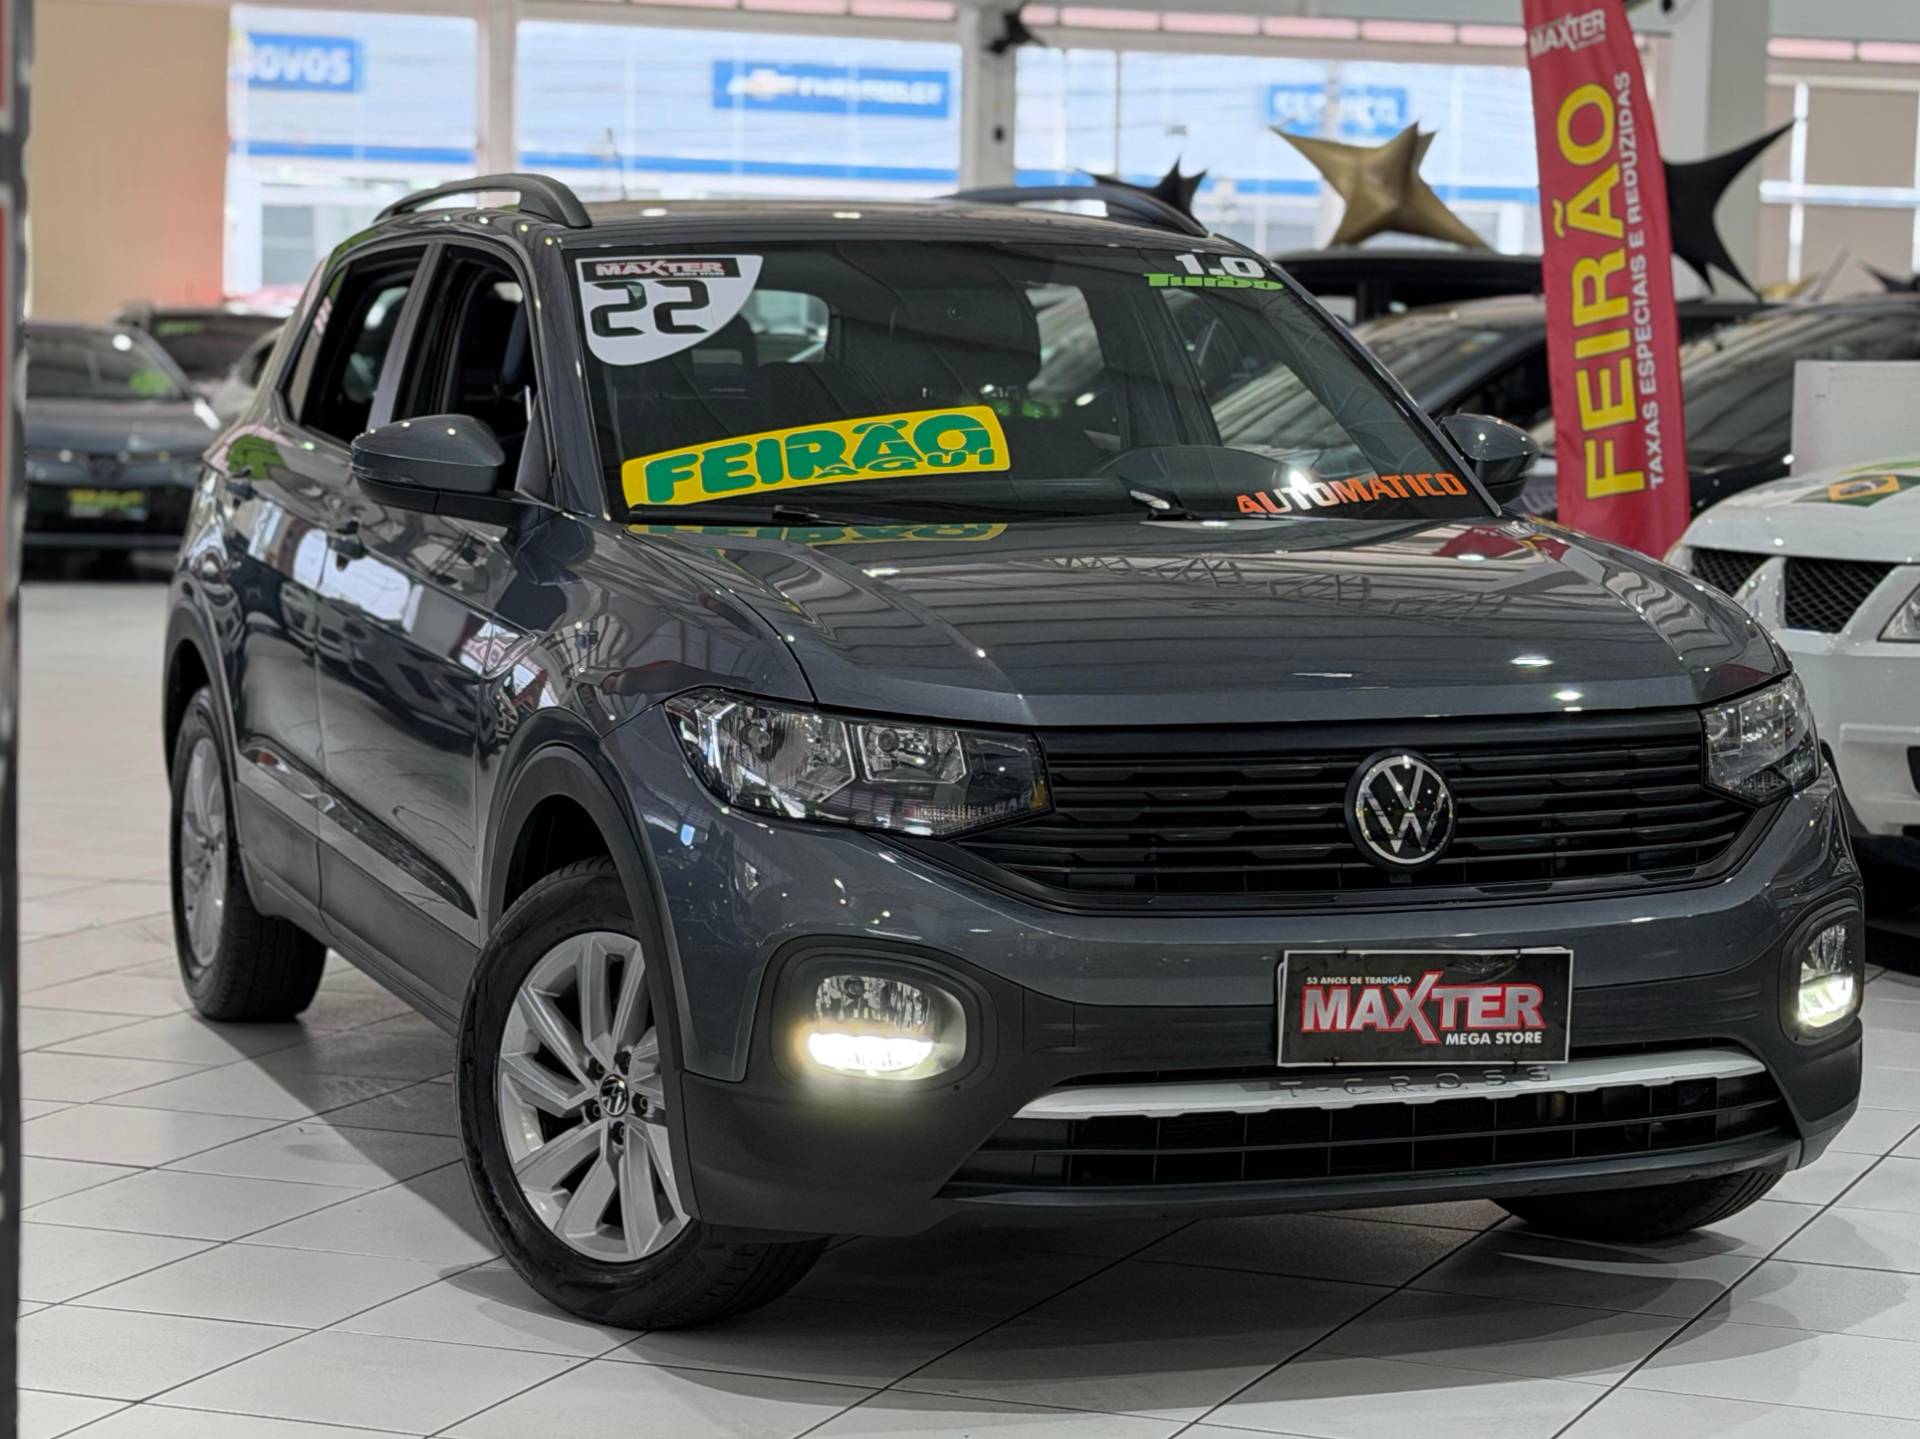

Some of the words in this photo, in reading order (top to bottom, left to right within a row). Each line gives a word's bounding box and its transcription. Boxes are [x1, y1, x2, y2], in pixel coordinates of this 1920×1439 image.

[1529, 8, 1605, 58] MAXTER
[1615, 71, 1643, 223] REDUZIDAS
[1628, 229, 1645, 248] E
[595, 260, 724, 276] MAXTER
[1174, 253, 1265, 279] 1.0
[1553, 83, 1645, 499] FEIRÃO
[590, 279, 710, 338] 22
[1630, 254, 1657, 394] ESPECIAIS
[645, 413, 991, 503] FEIRÃO
[1642, 401, 1664, 489] TAXAS
[1320, 976, 1348, 985] ANOS
[1350, 976, 1363, 985] DE
[1365, 974, 1411, 985] TRADIÇÃO
[1302, 970, 1546, 1045] MAXTER
[1445, 1032, 1491, 1045] MEGA
[1495, 1031, 1543, 1045] STORE
[1279, 1065, 1551, 1098] T-CROSS
